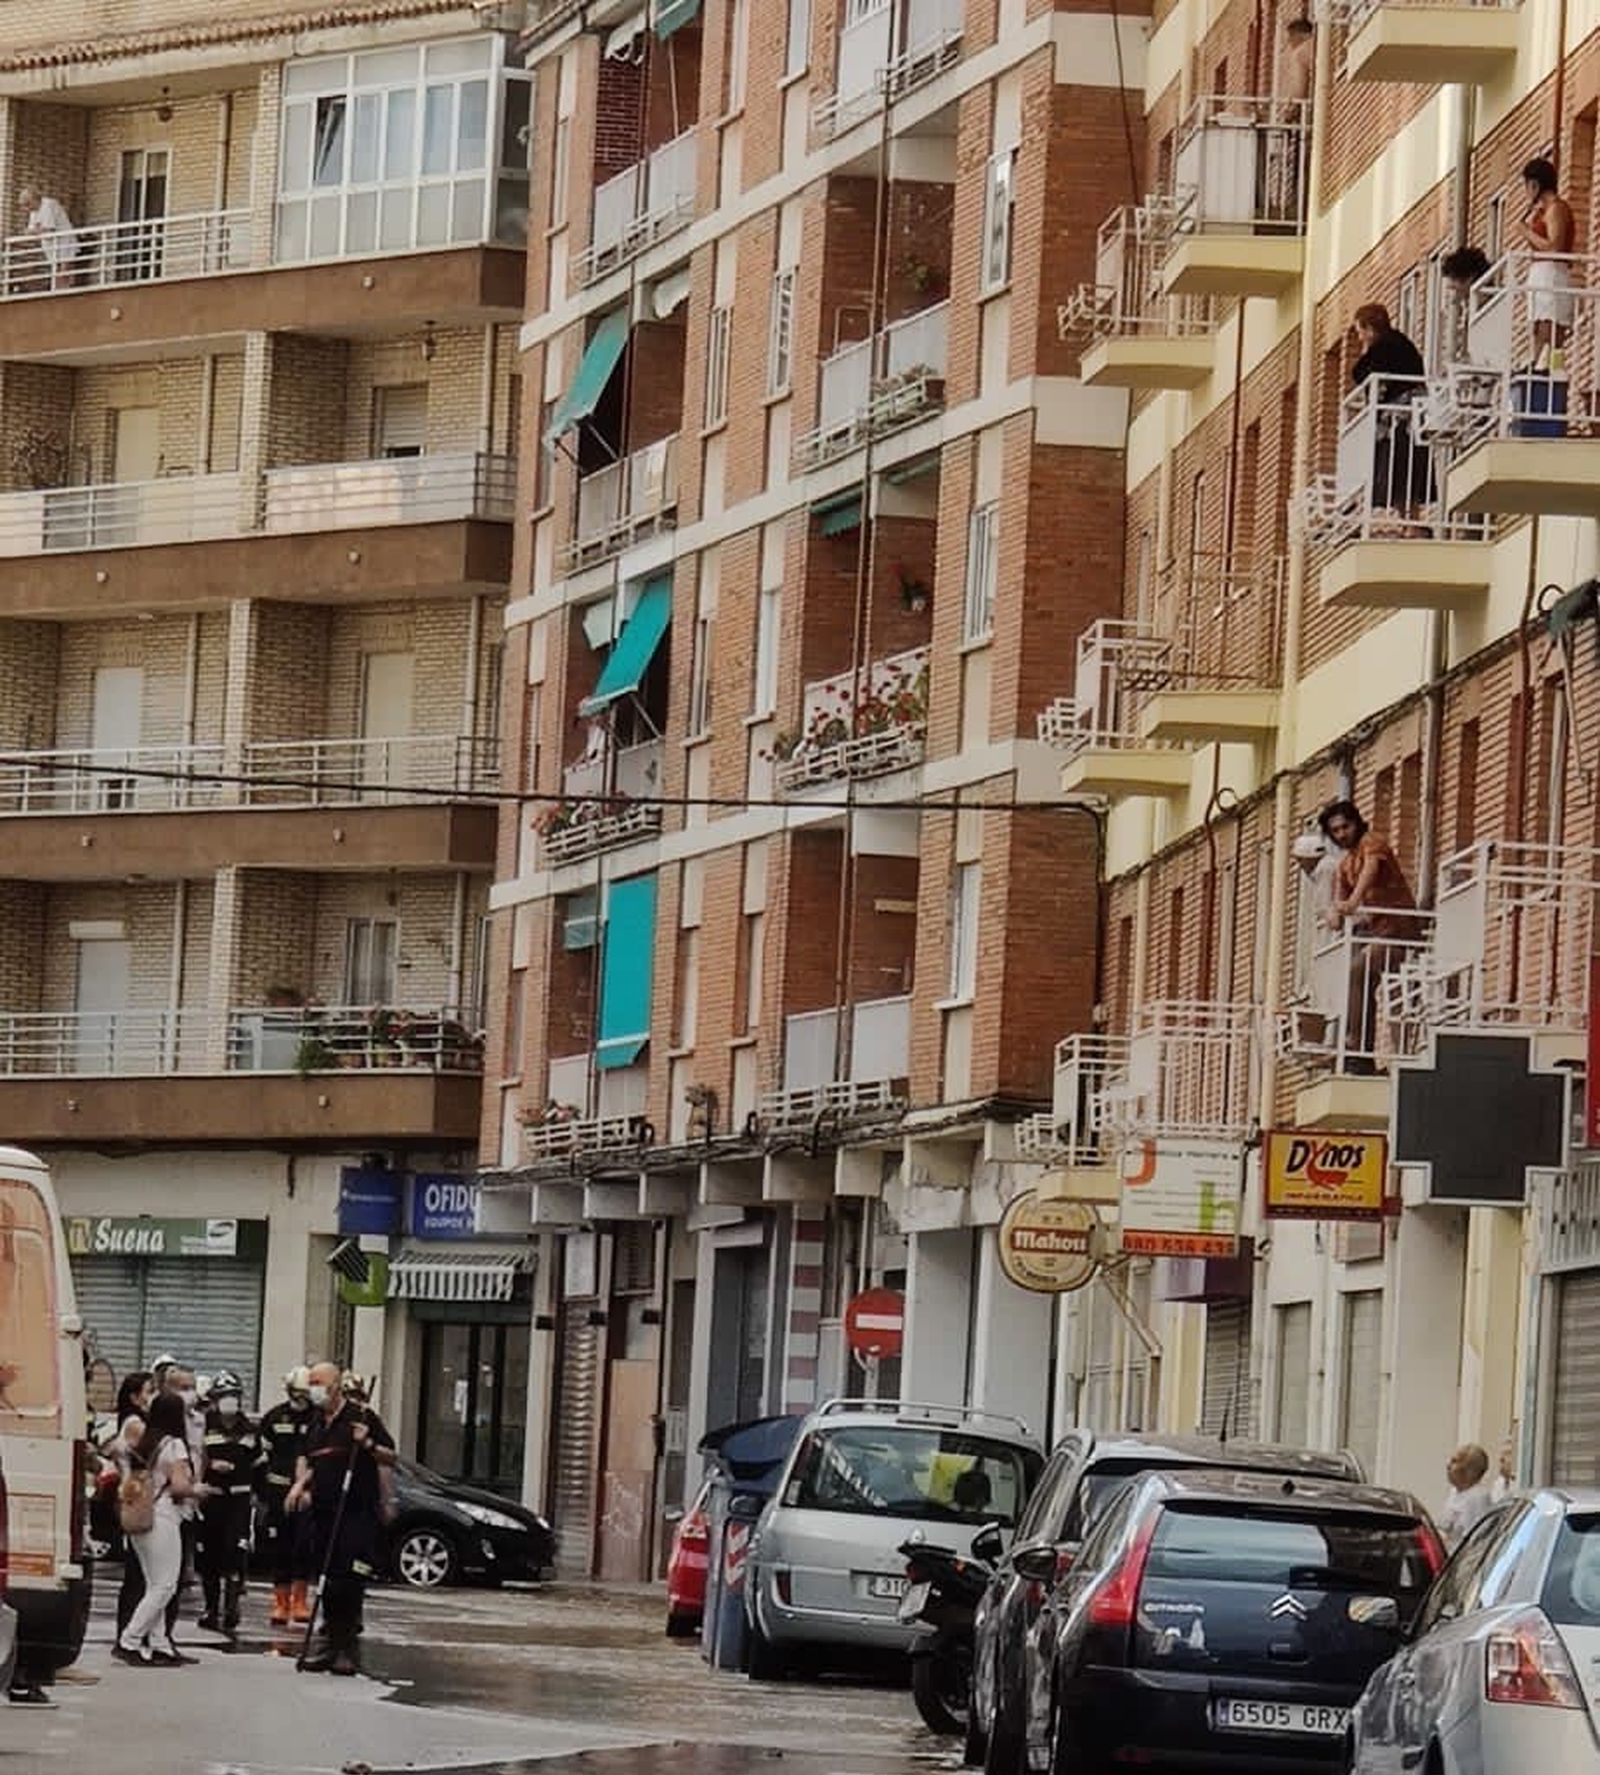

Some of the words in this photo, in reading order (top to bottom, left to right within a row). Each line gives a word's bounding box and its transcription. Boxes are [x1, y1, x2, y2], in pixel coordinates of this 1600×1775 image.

[95, 1218, 166, 1254] Suena
[1014, 1231, 1087, 1252] Mahou
[1232, 1703, 1291, 1726] 6505
[1303, 1707, 1347, 1731] GRX
